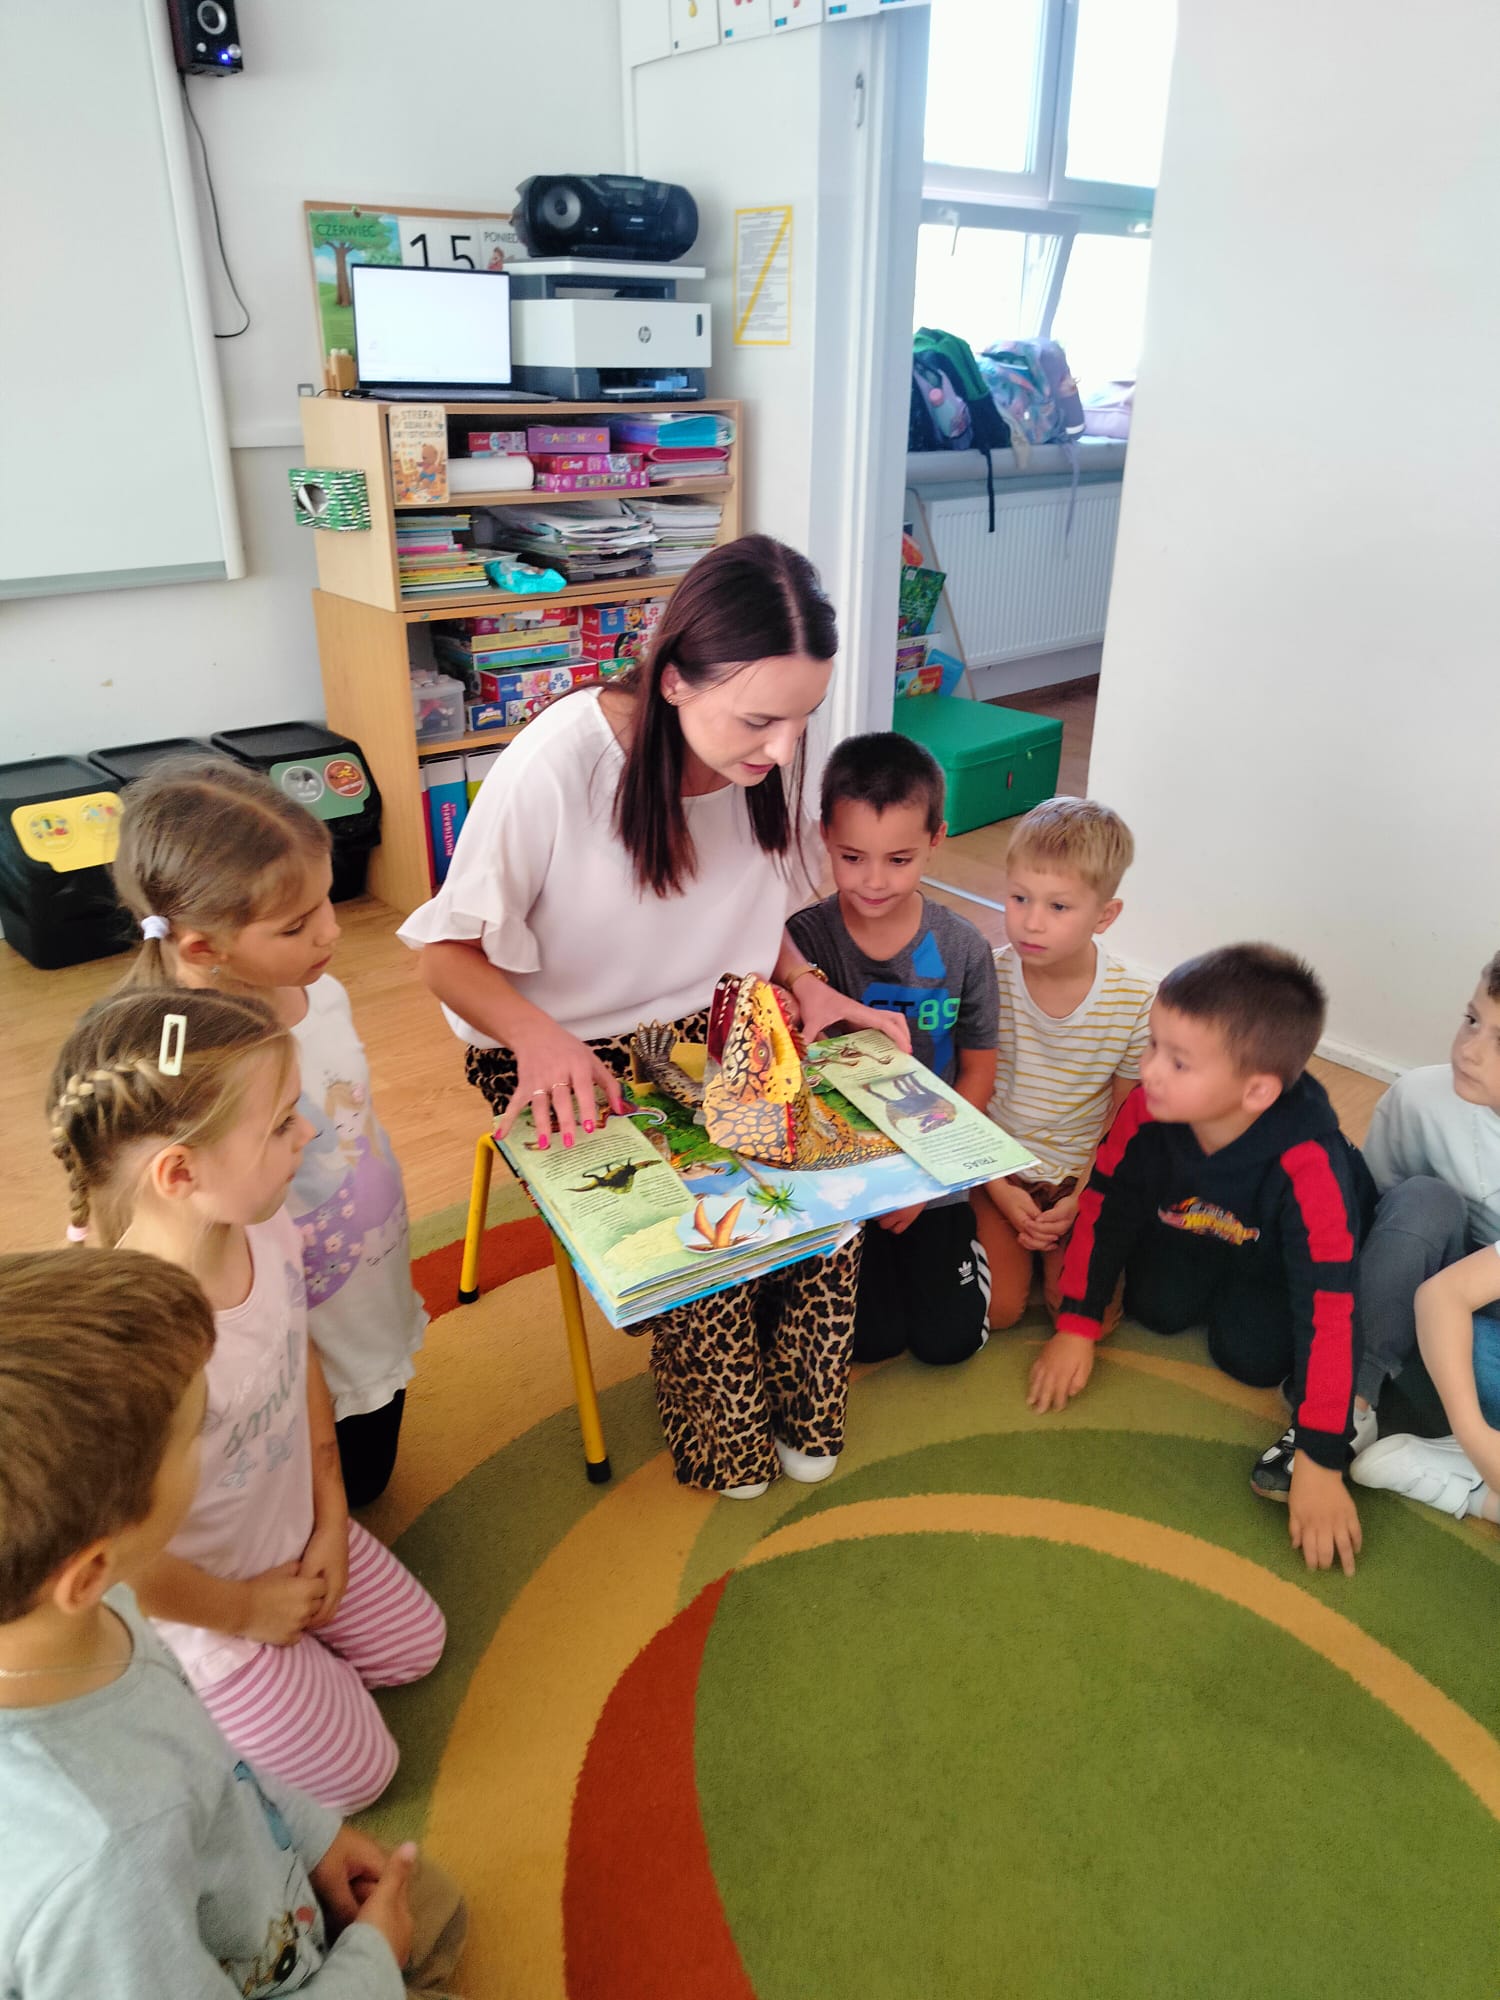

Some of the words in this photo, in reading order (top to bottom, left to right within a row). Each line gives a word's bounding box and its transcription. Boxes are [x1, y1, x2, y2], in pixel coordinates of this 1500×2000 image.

[315, 224, 378, 238] CZERWIEC
[410, 233, 476, 270] 15
[917, 997, 961, 1031] 89
[962, 1156, 998, 1170] TRIAS
